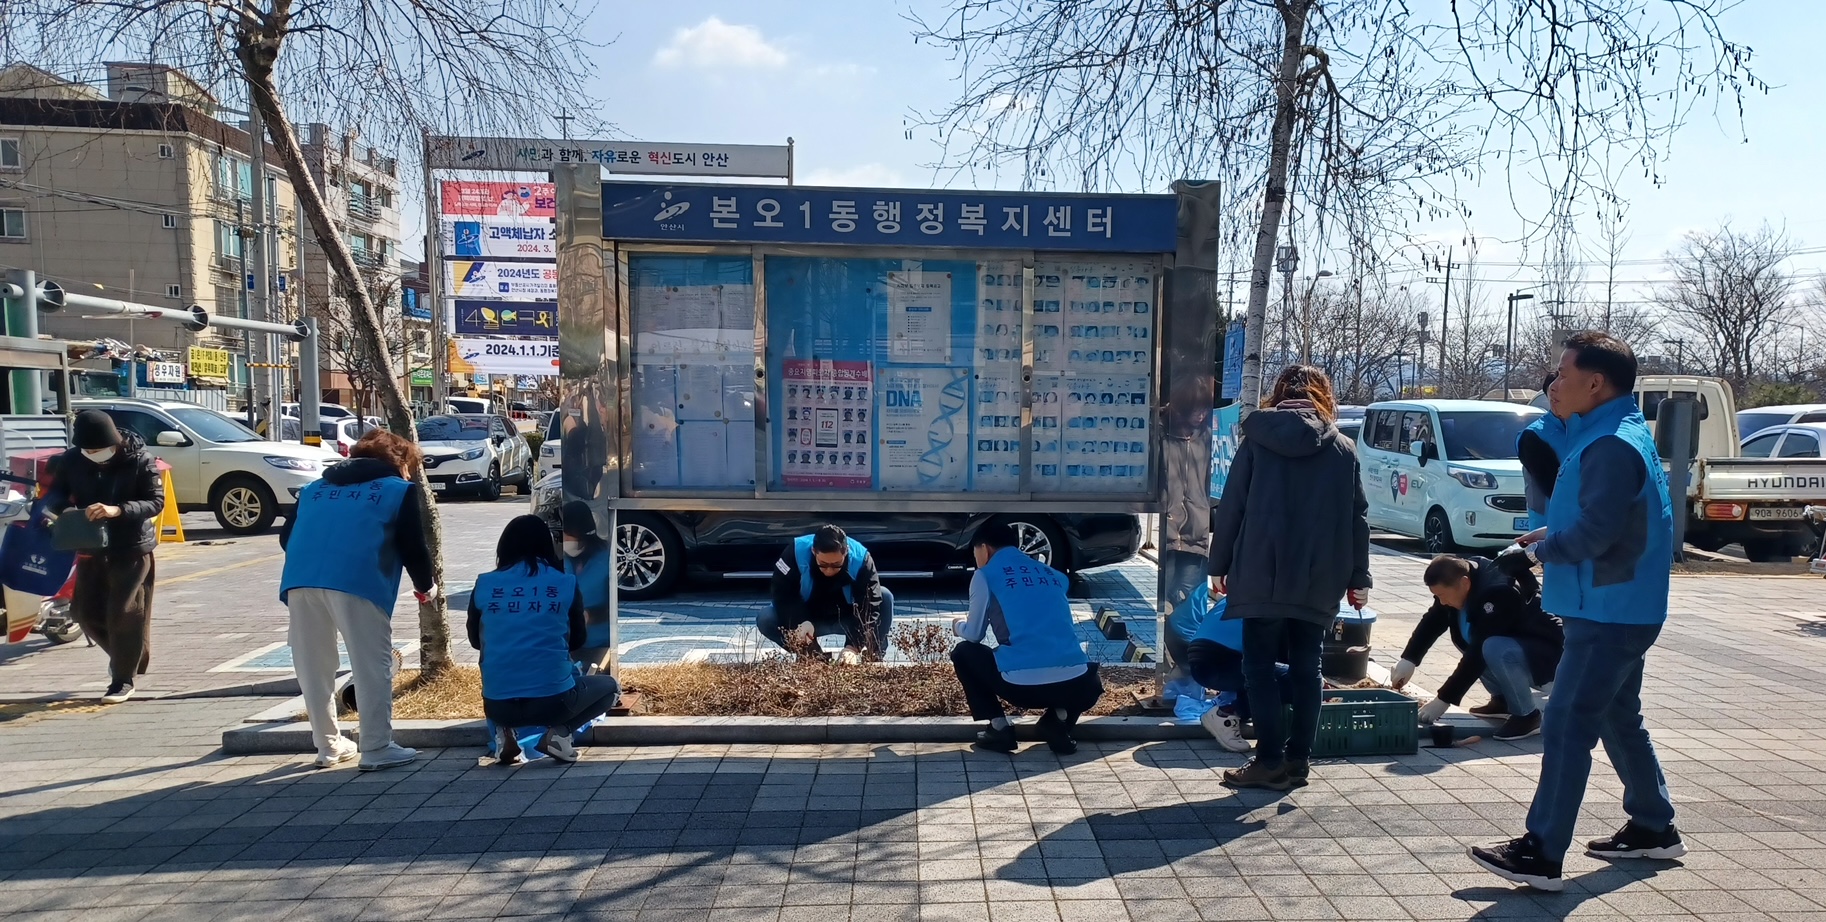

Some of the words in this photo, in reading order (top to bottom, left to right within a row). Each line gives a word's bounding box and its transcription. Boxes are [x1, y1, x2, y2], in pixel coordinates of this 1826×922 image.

[591, 149, 641, 165] 자유로운
[648, 151, 696, 166] 혁신도시
[702, 152, 728, 167] 안산
[489, 226, 545, 240] 고액체납자
[660, 223, 684, 231] 안산시
[497, 268, 540, 279] 2024년도
[886, 390, 922, 407] DNA
[821, 420, 834, 429] 112
[1411, 480, 1424, 489] EV
[1748, 477, 1825, 488] HYUNDAI
[311, 489, 382, 505] 주민자치
[1776, 509, 1799, 518] 9606
[1005, 576, 1062, 589] 주민자치
[491, 586, 559, 598] 본오1동
[487, 601, 561, 614] 주민자치
